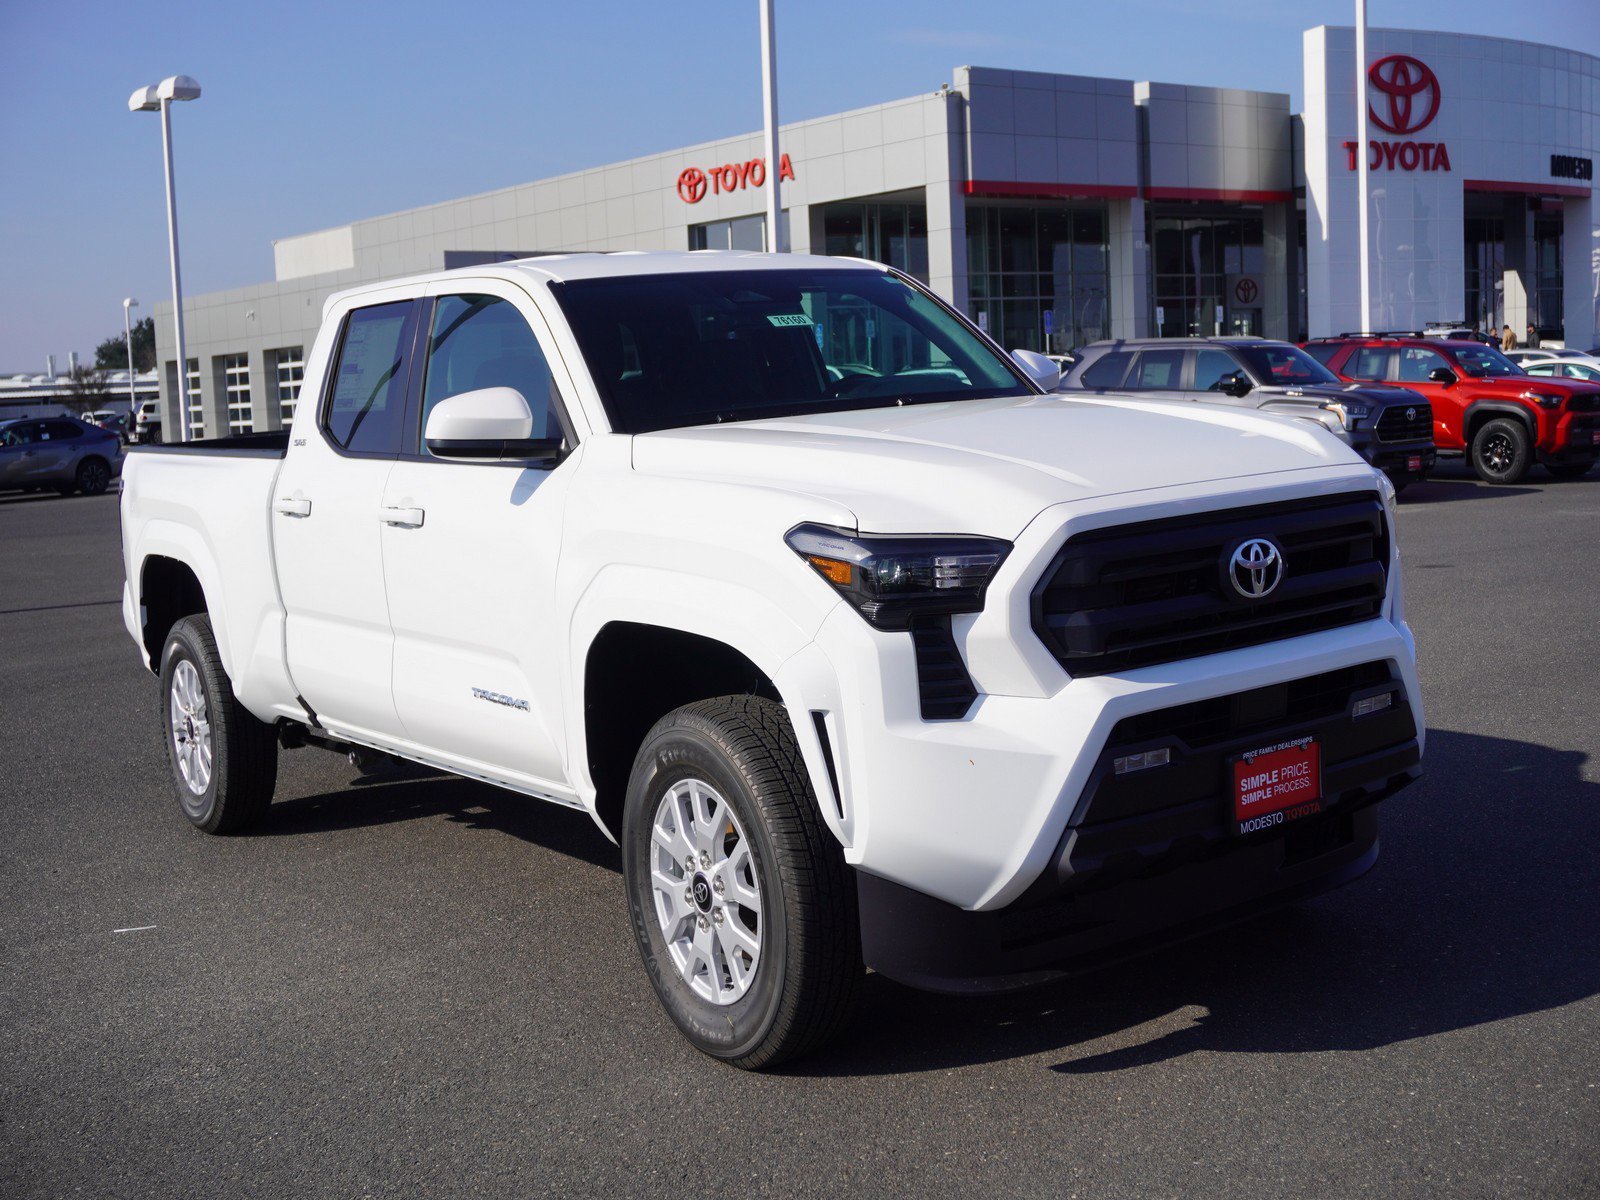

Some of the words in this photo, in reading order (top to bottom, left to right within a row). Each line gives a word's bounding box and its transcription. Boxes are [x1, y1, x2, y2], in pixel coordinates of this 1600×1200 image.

[1343, 140, 1451, 171] TOYOTA
[1550, 153, 1593, 181] MODESTO
[708, 153, 795, 195] TOYOA
[773, 315, 807, 326] 76160
[471, 686, 531, 713] TACOMA
[1242, 749, 1258, 760] PRICE
[1258, 744, 1277, 755] FAMILY
[1277, 736, 1313, 751] DEALERSHIPS
[1240, 770, 1279, 792] SIMPLE
[1281, 761, 1311, 780] PRICE.
[1241, 787, 1272, 805] SIMPLE
[1273, 776, 1312, 796] PROCESS.
[1240, 812, 1284, 834] MODESTO
[1286, 802, 1321, 819] TOYOTA
